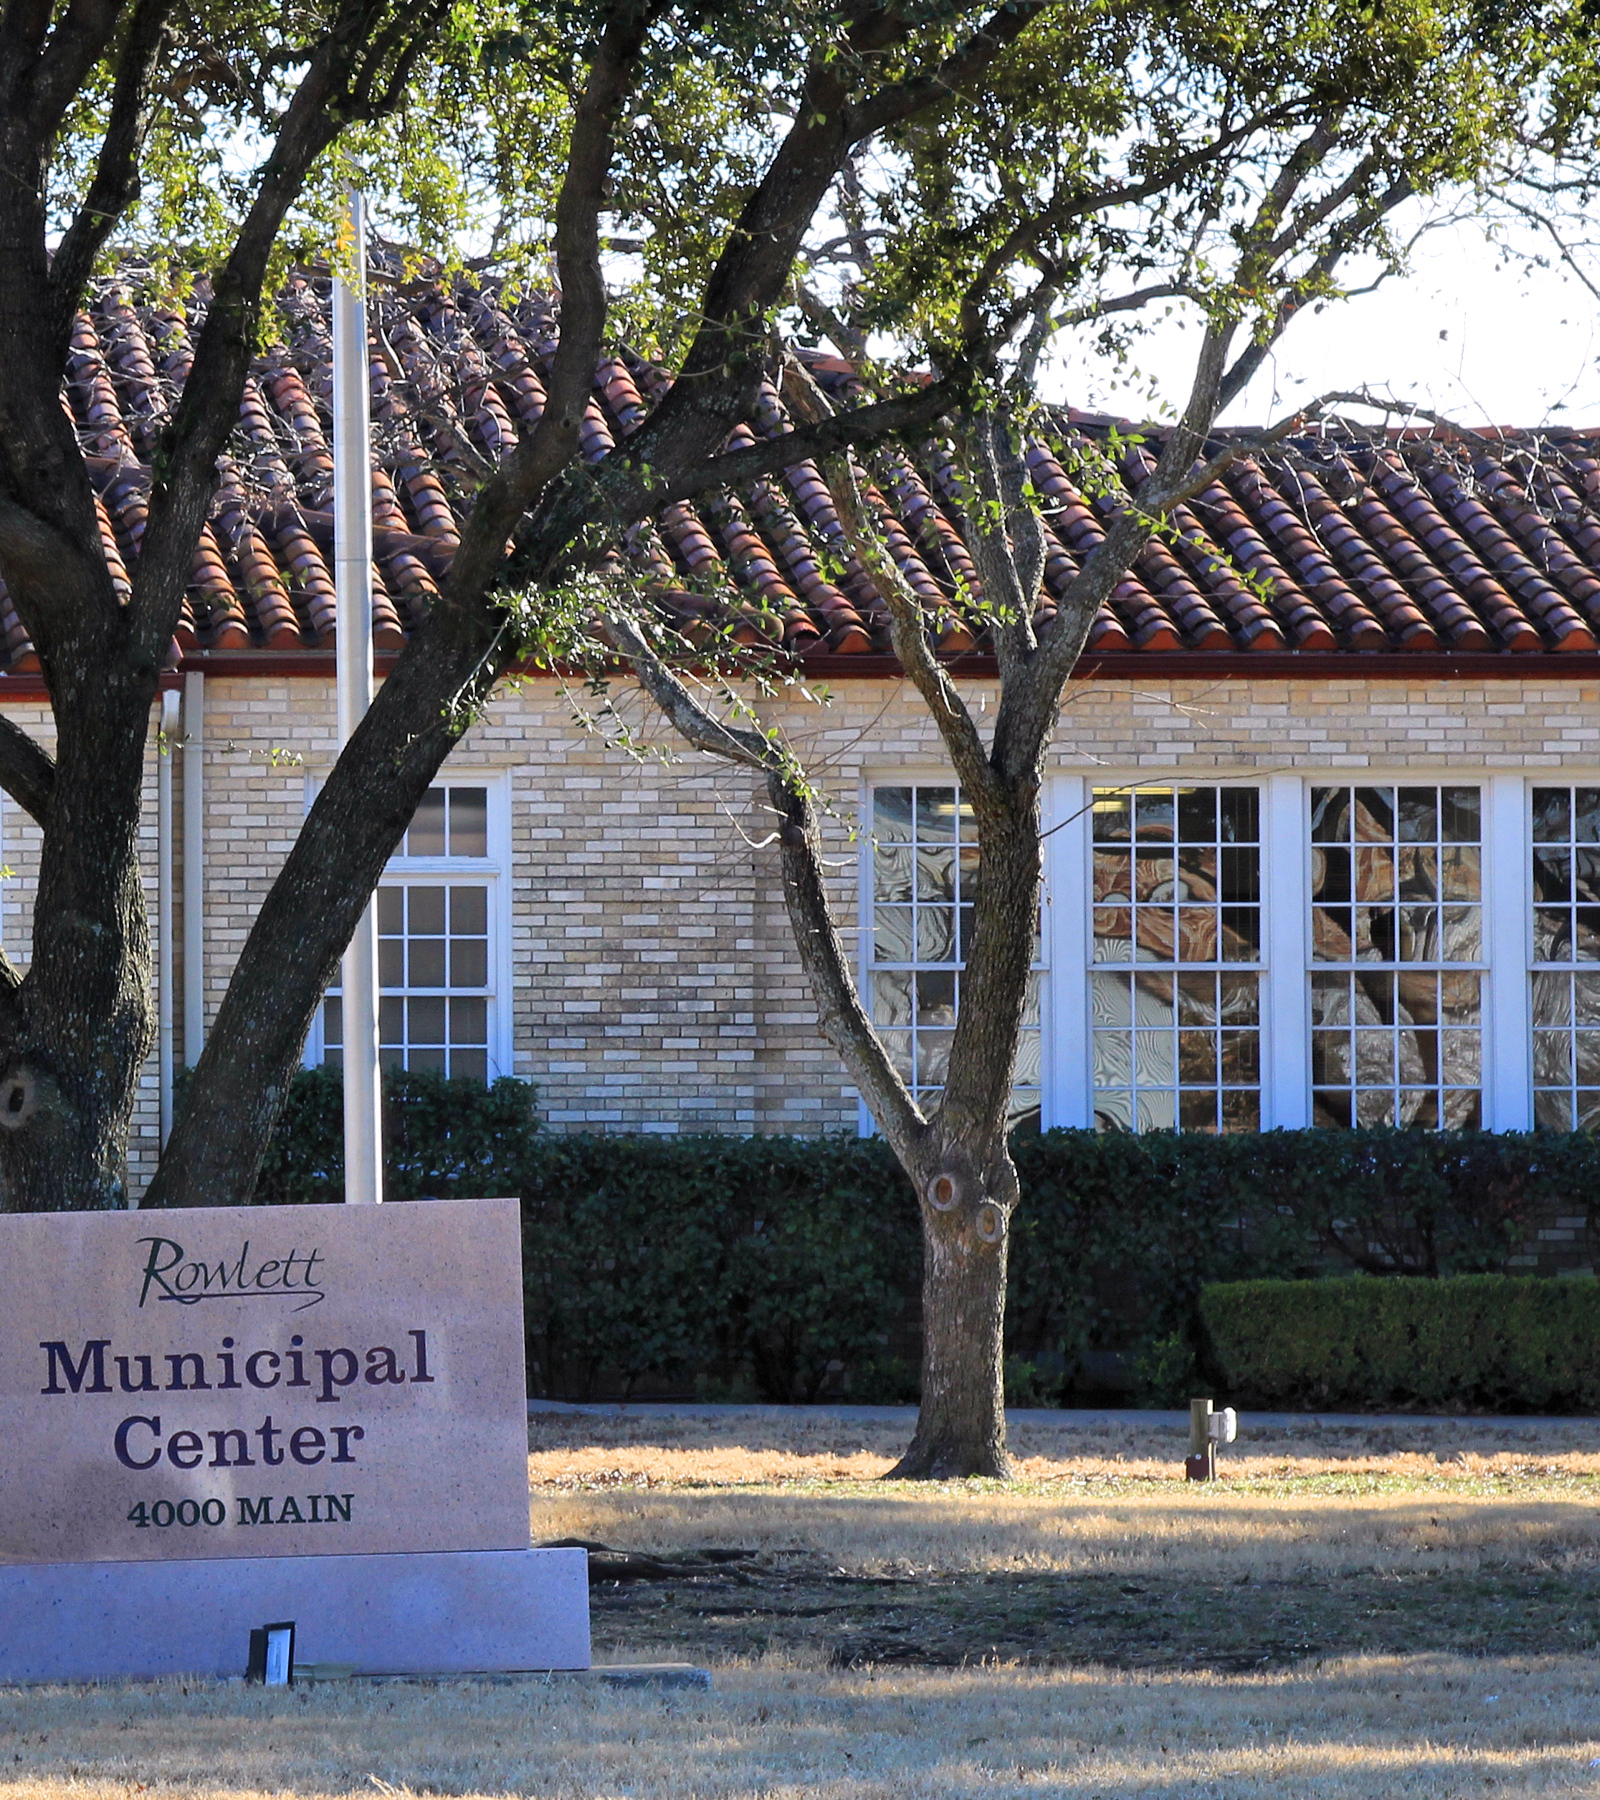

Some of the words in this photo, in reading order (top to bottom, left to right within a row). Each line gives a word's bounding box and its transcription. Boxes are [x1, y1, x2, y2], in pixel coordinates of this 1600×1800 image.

[136, 1236, 325, 1309] Rowlett
[39, 1329, 435, 1403] Municipal
[113, 1414, 366, 1471] Center
[127, 1498, 227, 1528] 4000
[235, 1493, 356, 1525] MAIN
